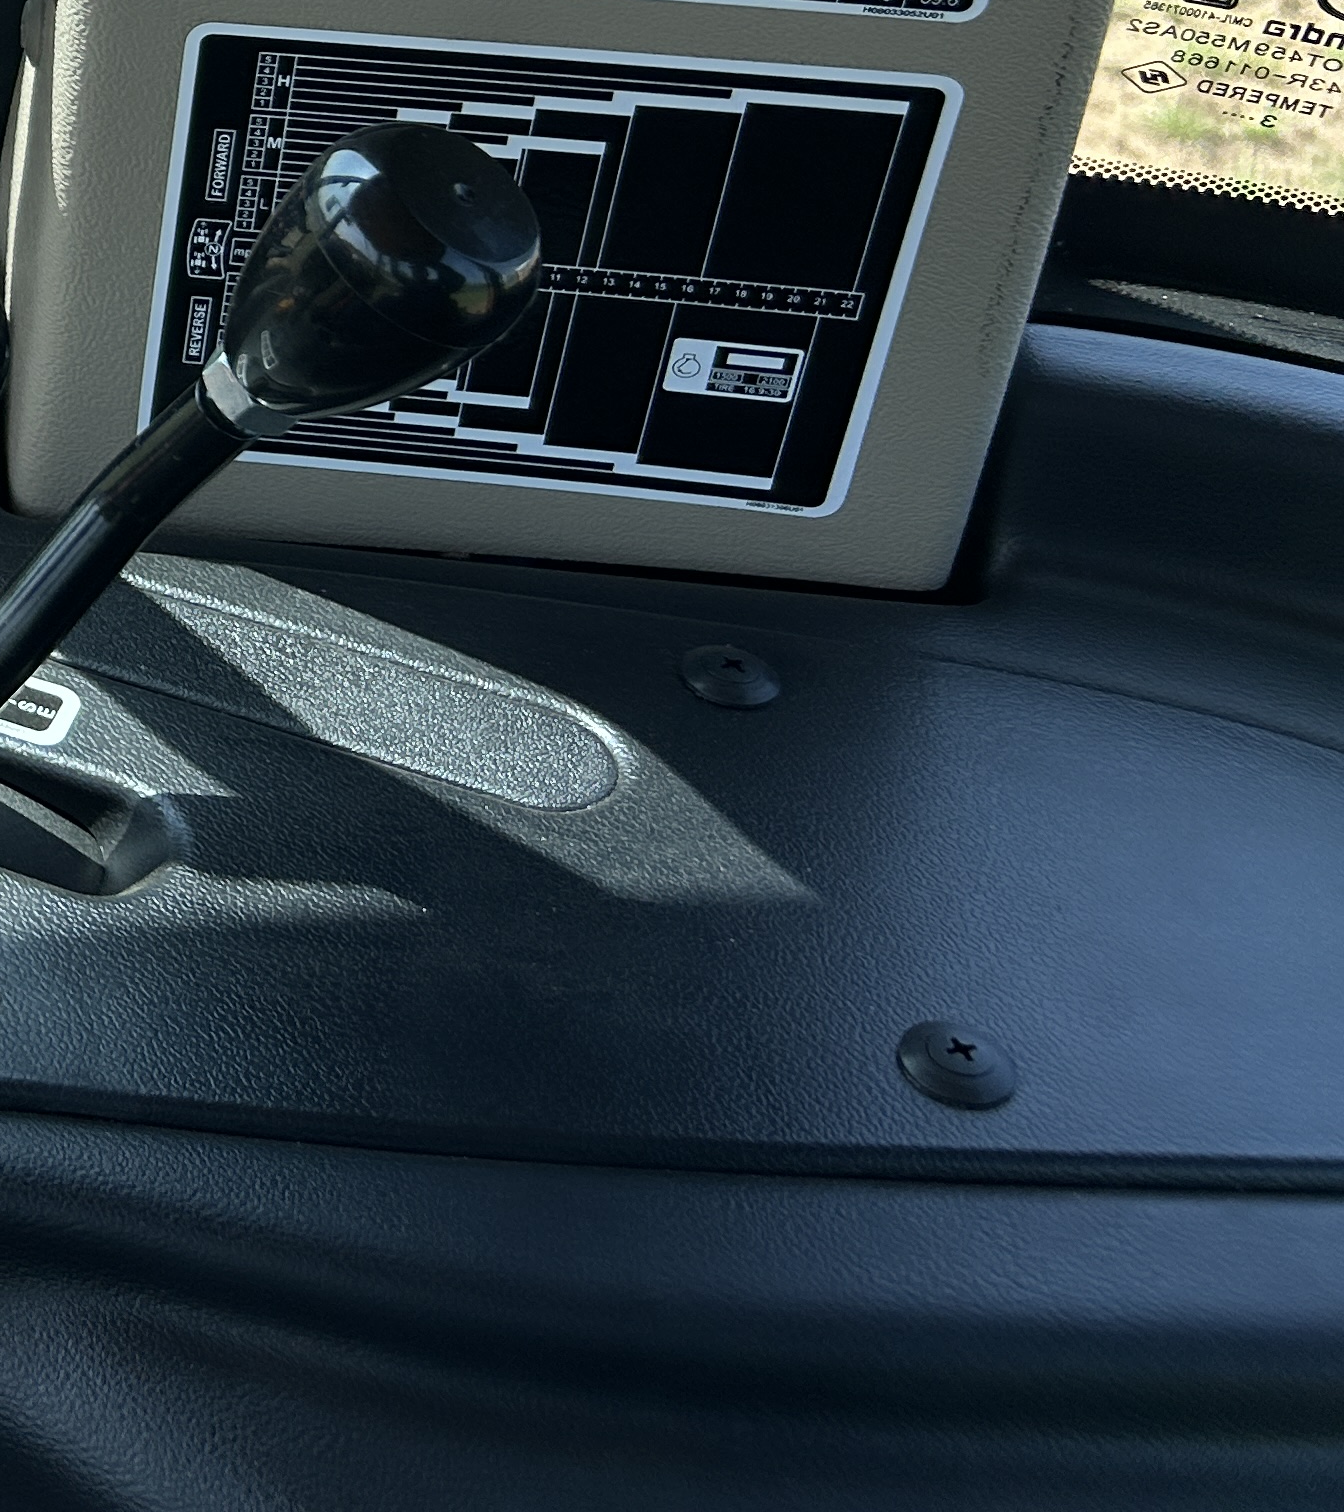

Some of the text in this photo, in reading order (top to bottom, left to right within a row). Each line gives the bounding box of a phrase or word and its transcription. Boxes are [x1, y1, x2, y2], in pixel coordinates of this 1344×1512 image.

[277, 74, 291, 88] H
[267, 136, 282, 149] M
[212, 134, 231, 197] FORWARD
[259, 197, 270, 210] L
[233, 247, 253, 258] mp
[550, 273, 854, 309] 11 12 13 14 15 16 17 18 19 20 21 22
[188, 303, 207, 357] REVERSE
